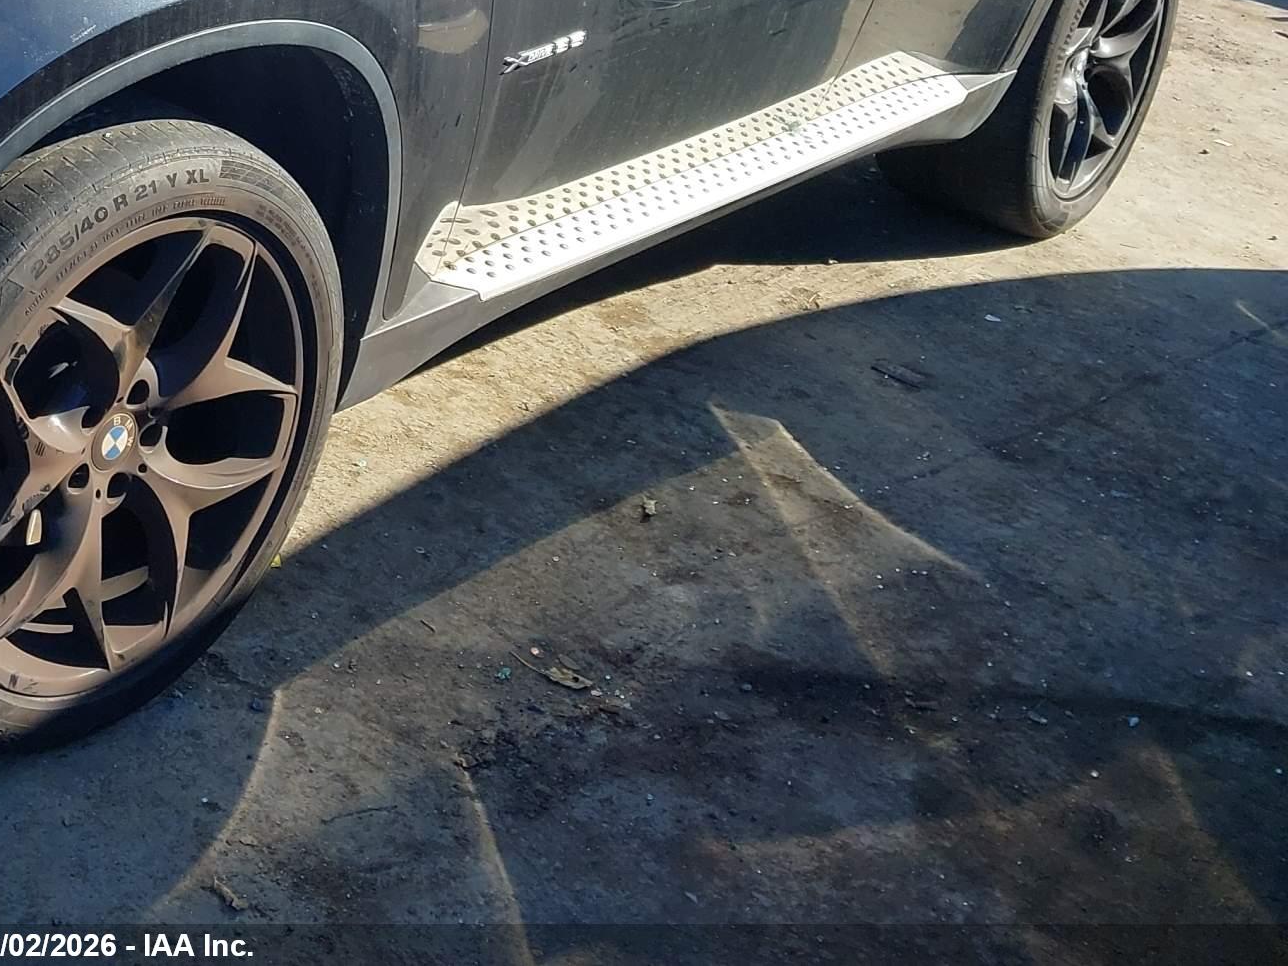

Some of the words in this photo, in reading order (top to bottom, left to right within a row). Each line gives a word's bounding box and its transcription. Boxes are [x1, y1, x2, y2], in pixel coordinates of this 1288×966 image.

[30, 206, 109, 281] 285/40
[112, 193, 129, 212] R
[133, 179, 158, 202] 21
[185, 168, 210, 185] XL
